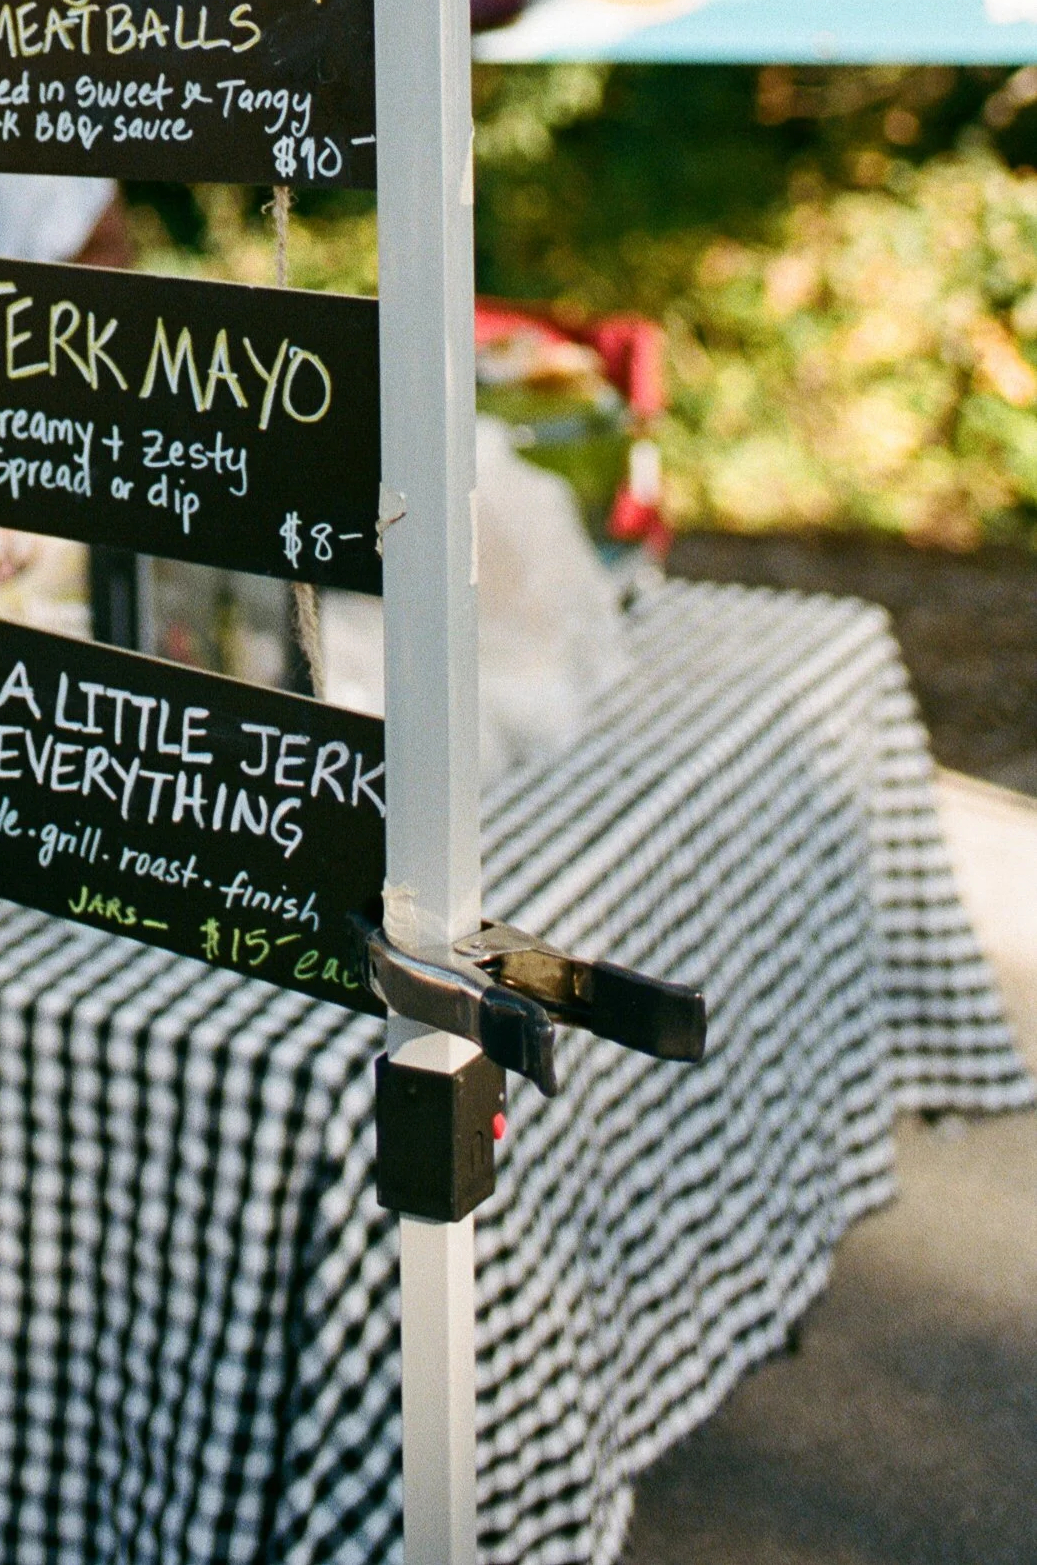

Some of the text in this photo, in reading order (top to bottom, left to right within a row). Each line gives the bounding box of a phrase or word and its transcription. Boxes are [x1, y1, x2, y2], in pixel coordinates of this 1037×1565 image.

[35, 111, 104, 150] BBQ
[112, 115, 193, 141] sauce
[39, 79, 64, 104] in
[181, 80, 213, 109] &
[216, 79, 313, 137] Tangy
[139, 317, 332, 431] MAYO
[101, 424, 124, 462] +
[142, 430, 247, 497] Zesty
[111, 477, 134, 500] or
[147, 473, 200, 534] dip
[55, 671, 214, 764] LITTLE
[240, 722, 387, 819] JERK
[219, 870, 321, 932] finish
